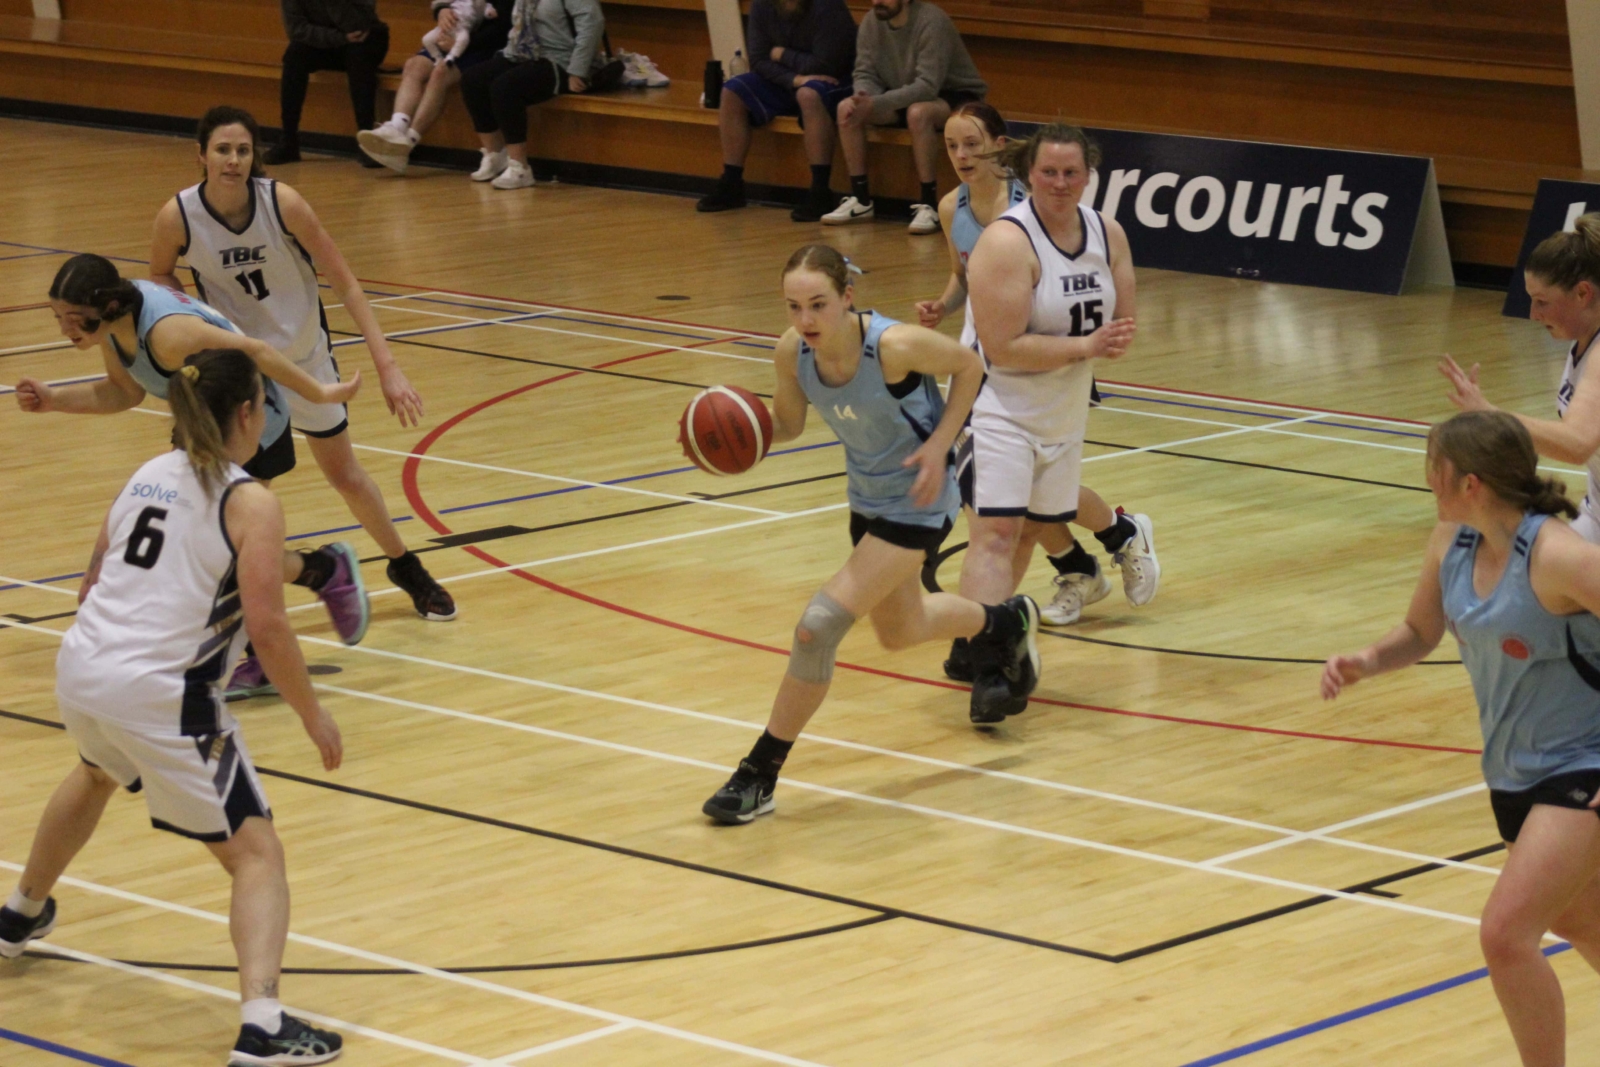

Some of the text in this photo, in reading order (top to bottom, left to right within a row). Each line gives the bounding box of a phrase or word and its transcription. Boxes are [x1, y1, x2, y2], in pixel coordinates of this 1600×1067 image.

[219, 245, 267, 265] TBC
[235, 269, 270, 301] 11
[1060, 271, 1101, 292] TBC
[1067, 299, 1103, 337] 15
[833, 404, 858, 420] 14
[130, 483, 178, 503] solve
[123, 505, 169, 570] 6
